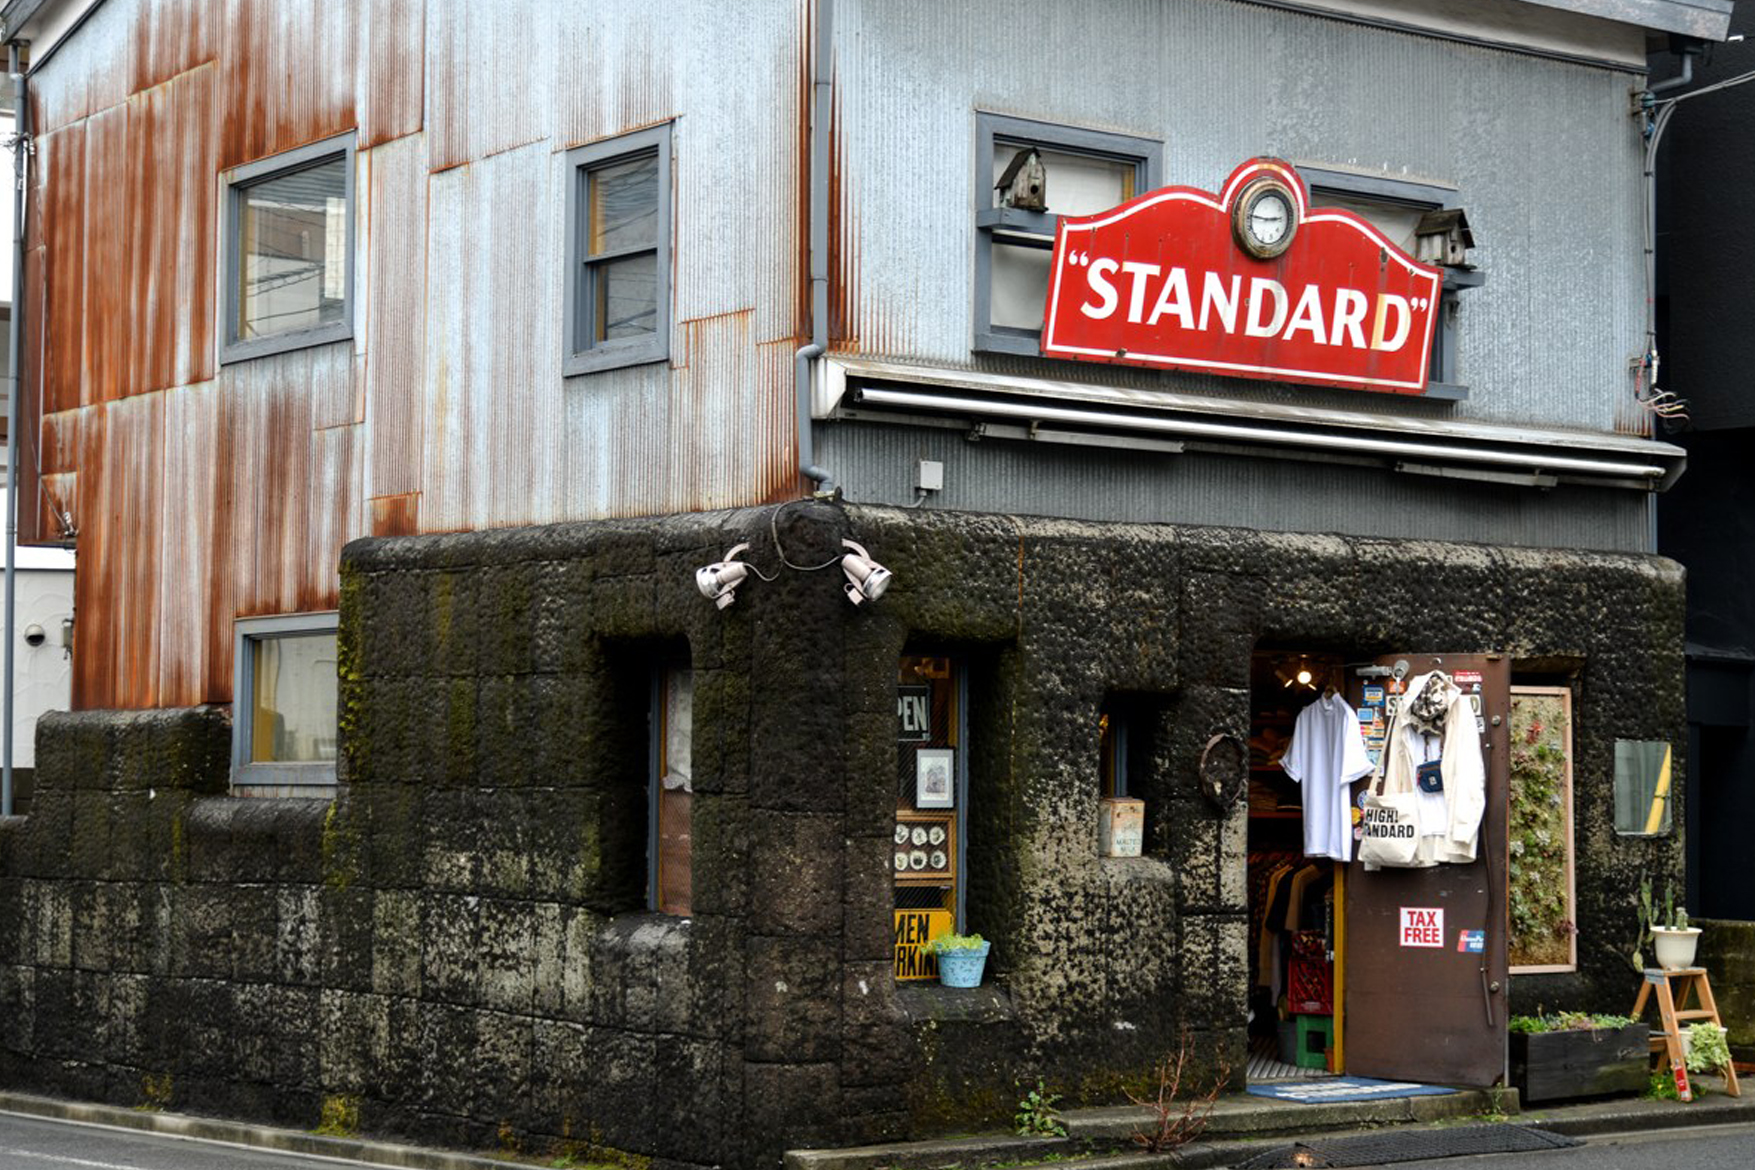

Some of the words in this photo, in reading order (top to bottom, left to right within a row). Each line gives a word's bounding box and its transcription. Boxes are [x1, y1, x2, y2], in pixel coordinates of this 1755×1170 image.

[1068, 250, 1429, 352] “STANDARD”
[1366, 808, 1399, 823] HIGH!
[1407, 911, 1436, 926] TAX
[1404, 927, 1440, 943] FREE
